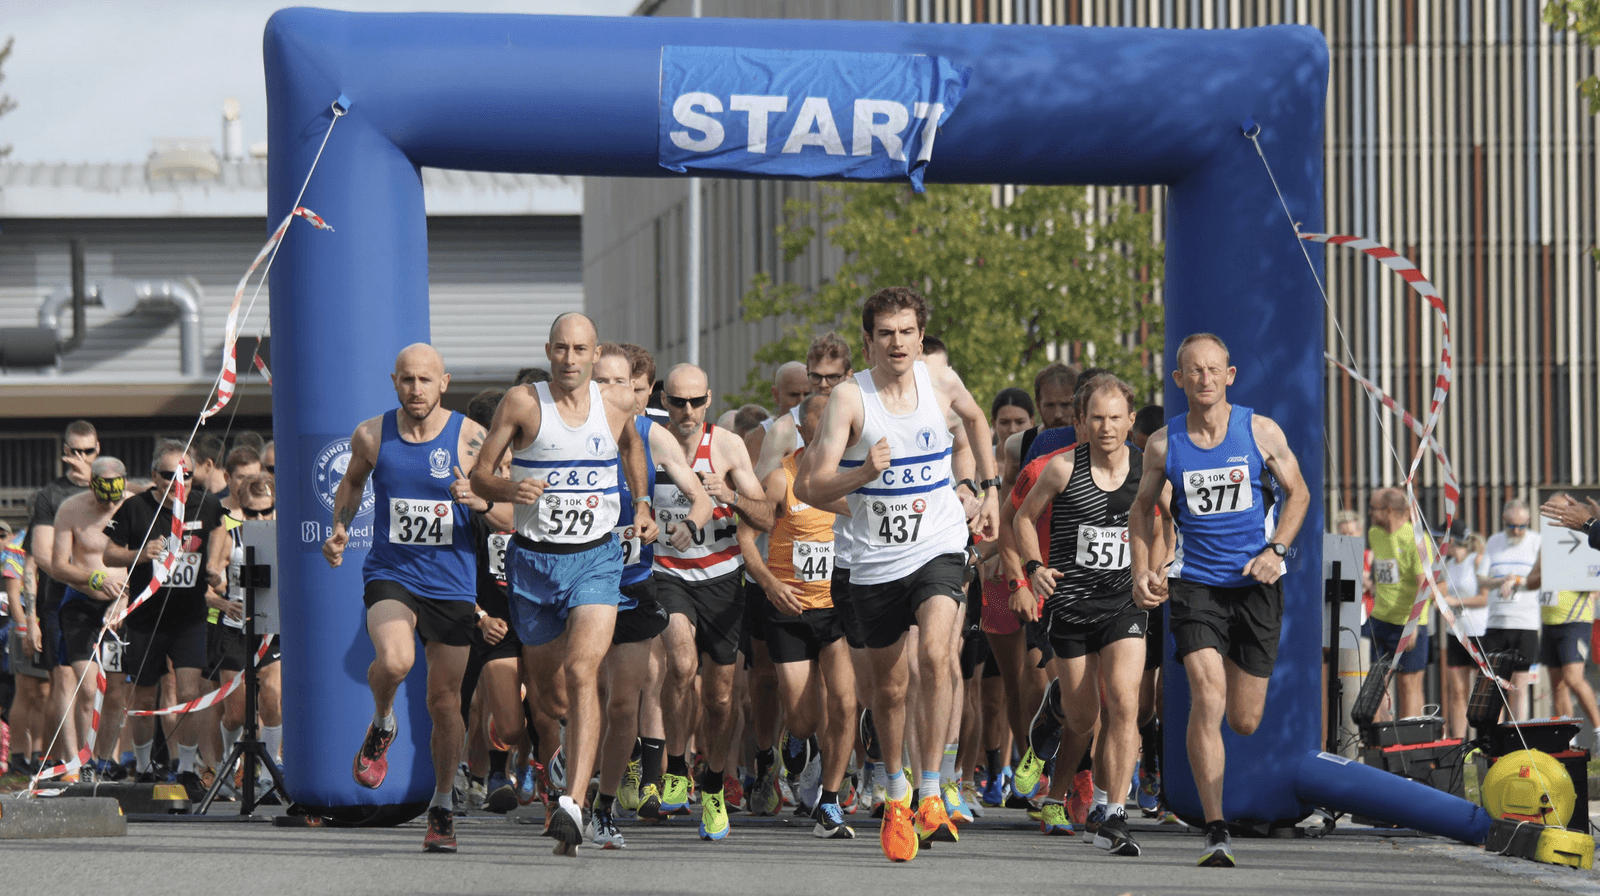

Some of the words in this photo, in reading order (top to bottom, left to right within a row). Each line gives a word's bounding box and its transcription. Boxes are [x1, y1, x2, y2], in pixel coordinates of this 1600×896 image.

[669, 91, 945, 162] START
[318, 442, 352, 470] ABINGT
[547, 471, 560, 486] C
[566, 470, 579, 486] &
[587, 470, 598, 486] C
[882, 470, 895, 485] C
[902, 468, 915, 484] &
[921, 465, 932, 481] C
[1207, 474, 1225, 482] 10K
[412, 505, 430, 513] 10K
[889, 503, 908, 511] 10K
[1196, 484, 1241, 513] 377
[325, 526, 369, 537] BMed
[398, 515, 443, 543] 324
[548, 509, 594, 536] 529
[878, 513, 923, 543] 437
[1084, 542, 1125, 568] 551
[802, 556, 829, 580] 44
[1539, 591, 1553, 605] 47
